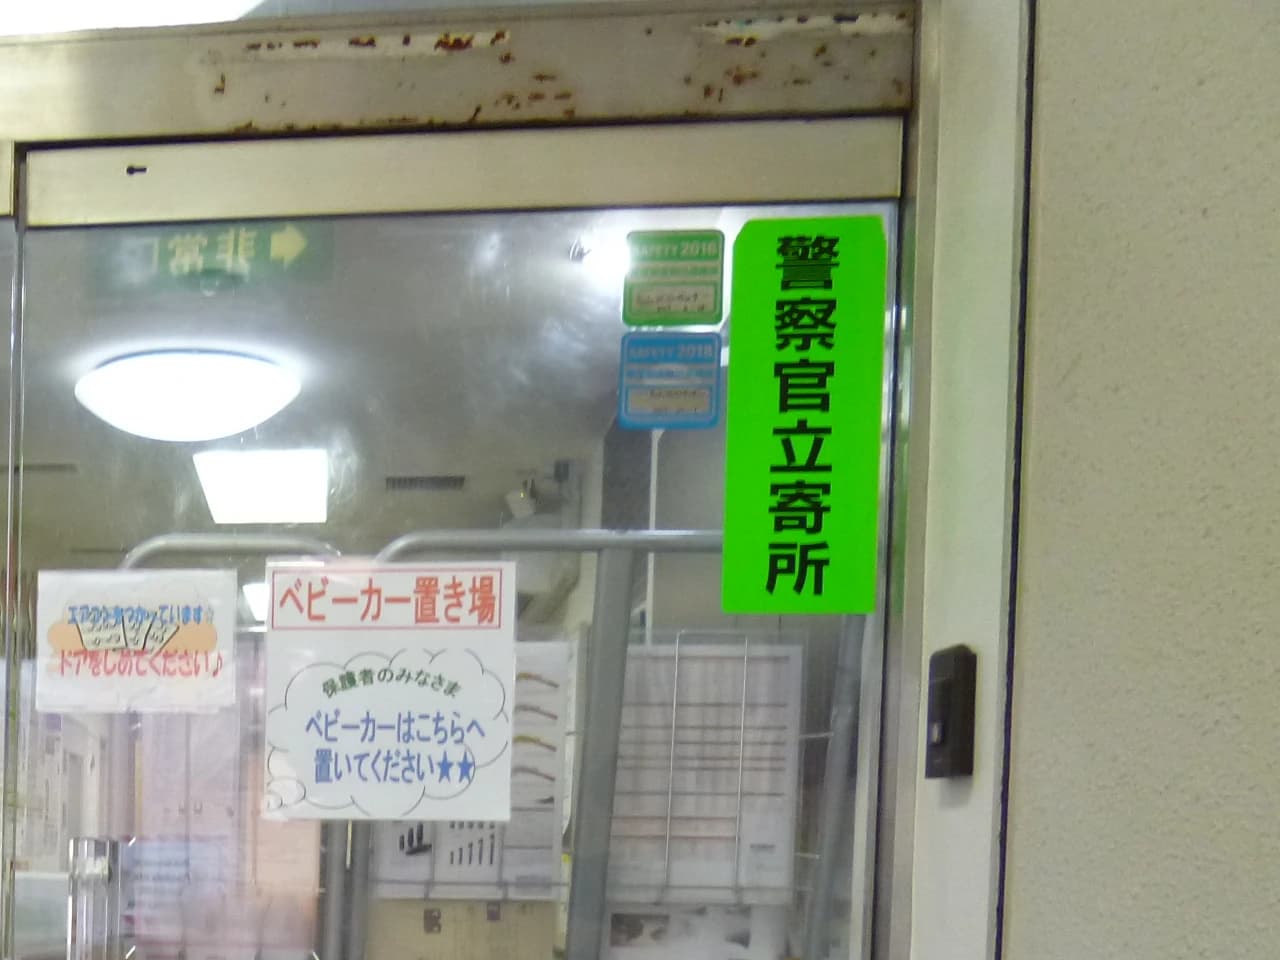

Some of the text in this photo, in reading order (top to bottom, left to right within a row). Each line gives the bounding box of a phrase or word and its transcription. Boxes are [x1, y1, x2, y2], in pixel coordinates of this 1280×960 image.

[765, 234, 841, 595] 警察官立寄所
[278, 575, 497, 625] ベビーカー置き場
[322, 666, 463, 699] 保護者のみなさま
